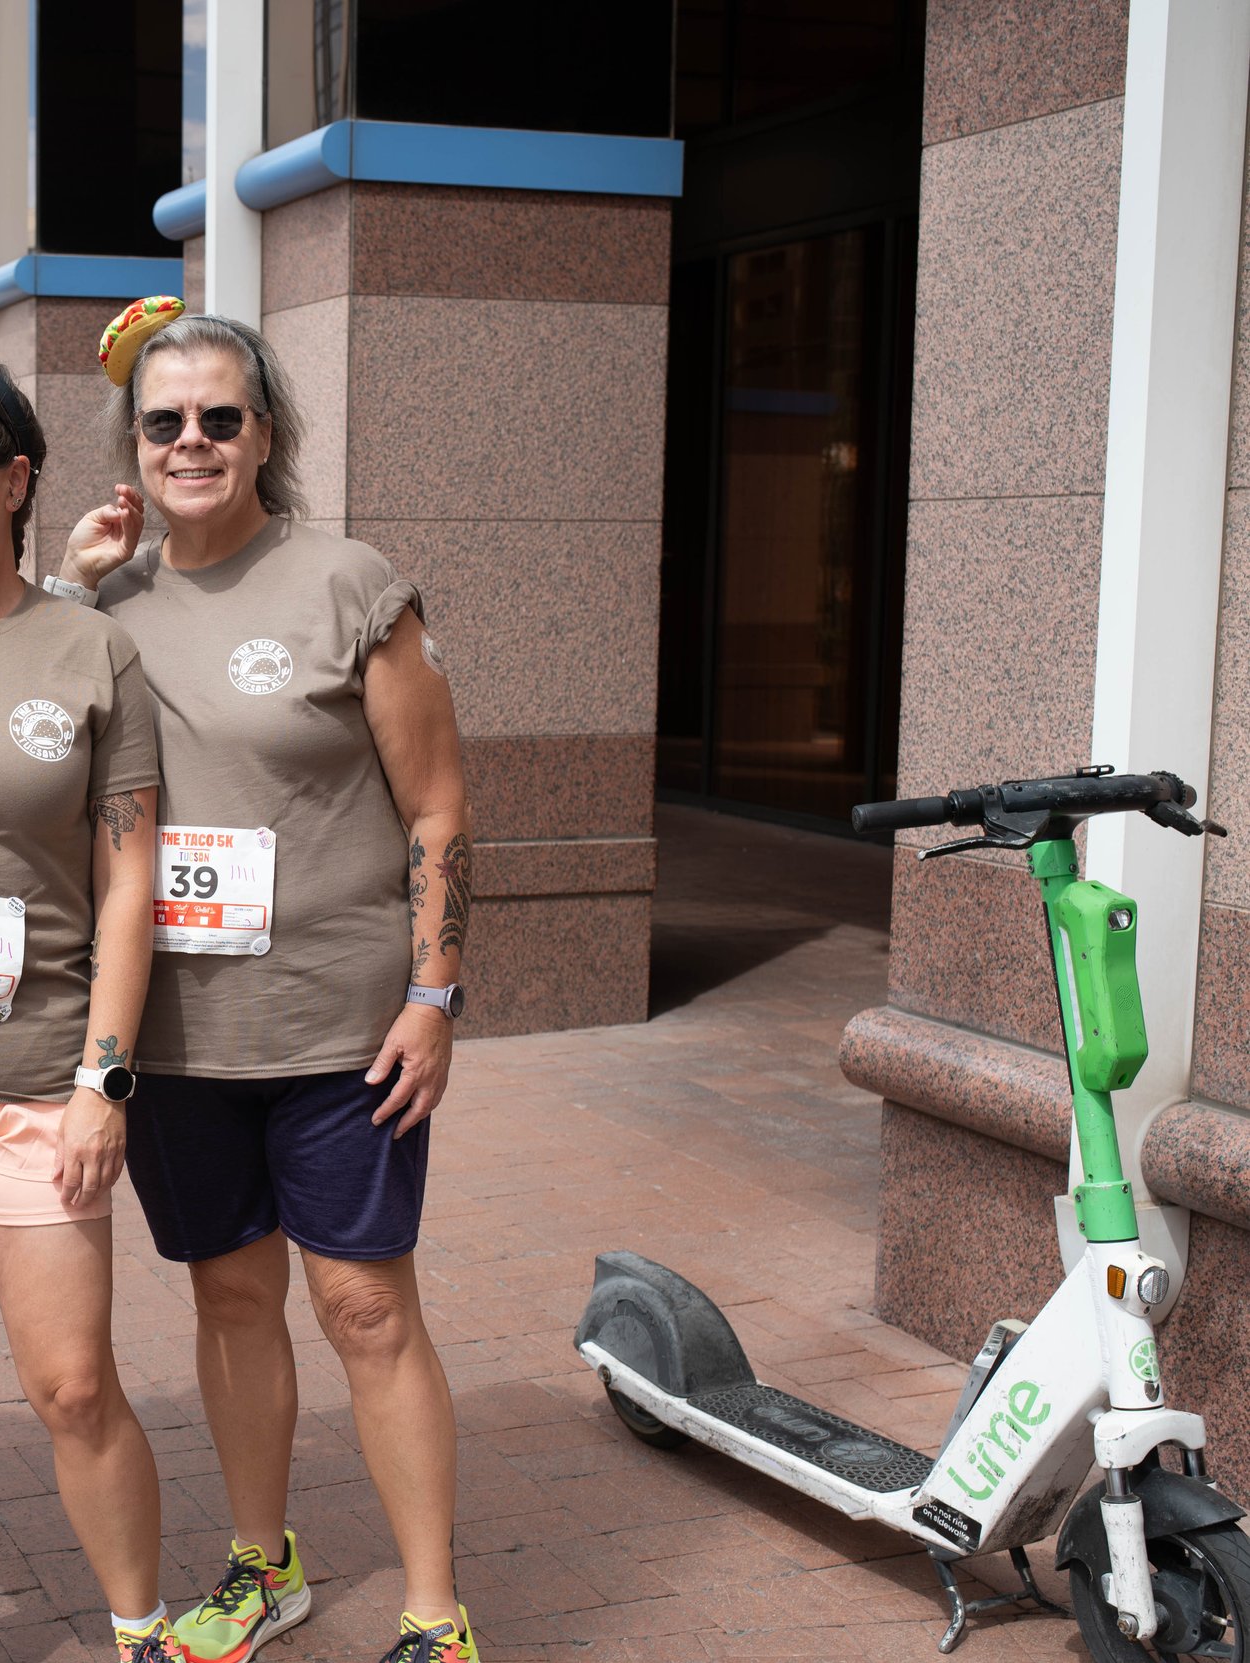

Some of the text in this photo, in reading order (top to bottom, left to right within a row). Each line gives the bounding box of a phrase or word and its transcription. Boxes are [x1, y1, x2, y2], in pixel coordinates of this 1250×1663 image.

[234, 645, 252, 660] THE
[252, 641, 275, 652] TACO
[14, 703, 31, 720] THE
[31, 702, 56, 714] TACO
[161, 832, 234, 848] THE TACO 5K
[179, 851, 210, 863] TUCSON
[169, 864, 219, 899] 39
[922, 1508, 970, 1542] on sidewalks
[938, 1509, 952, 1521] not
[952, 1517, 968, 1531] ride
